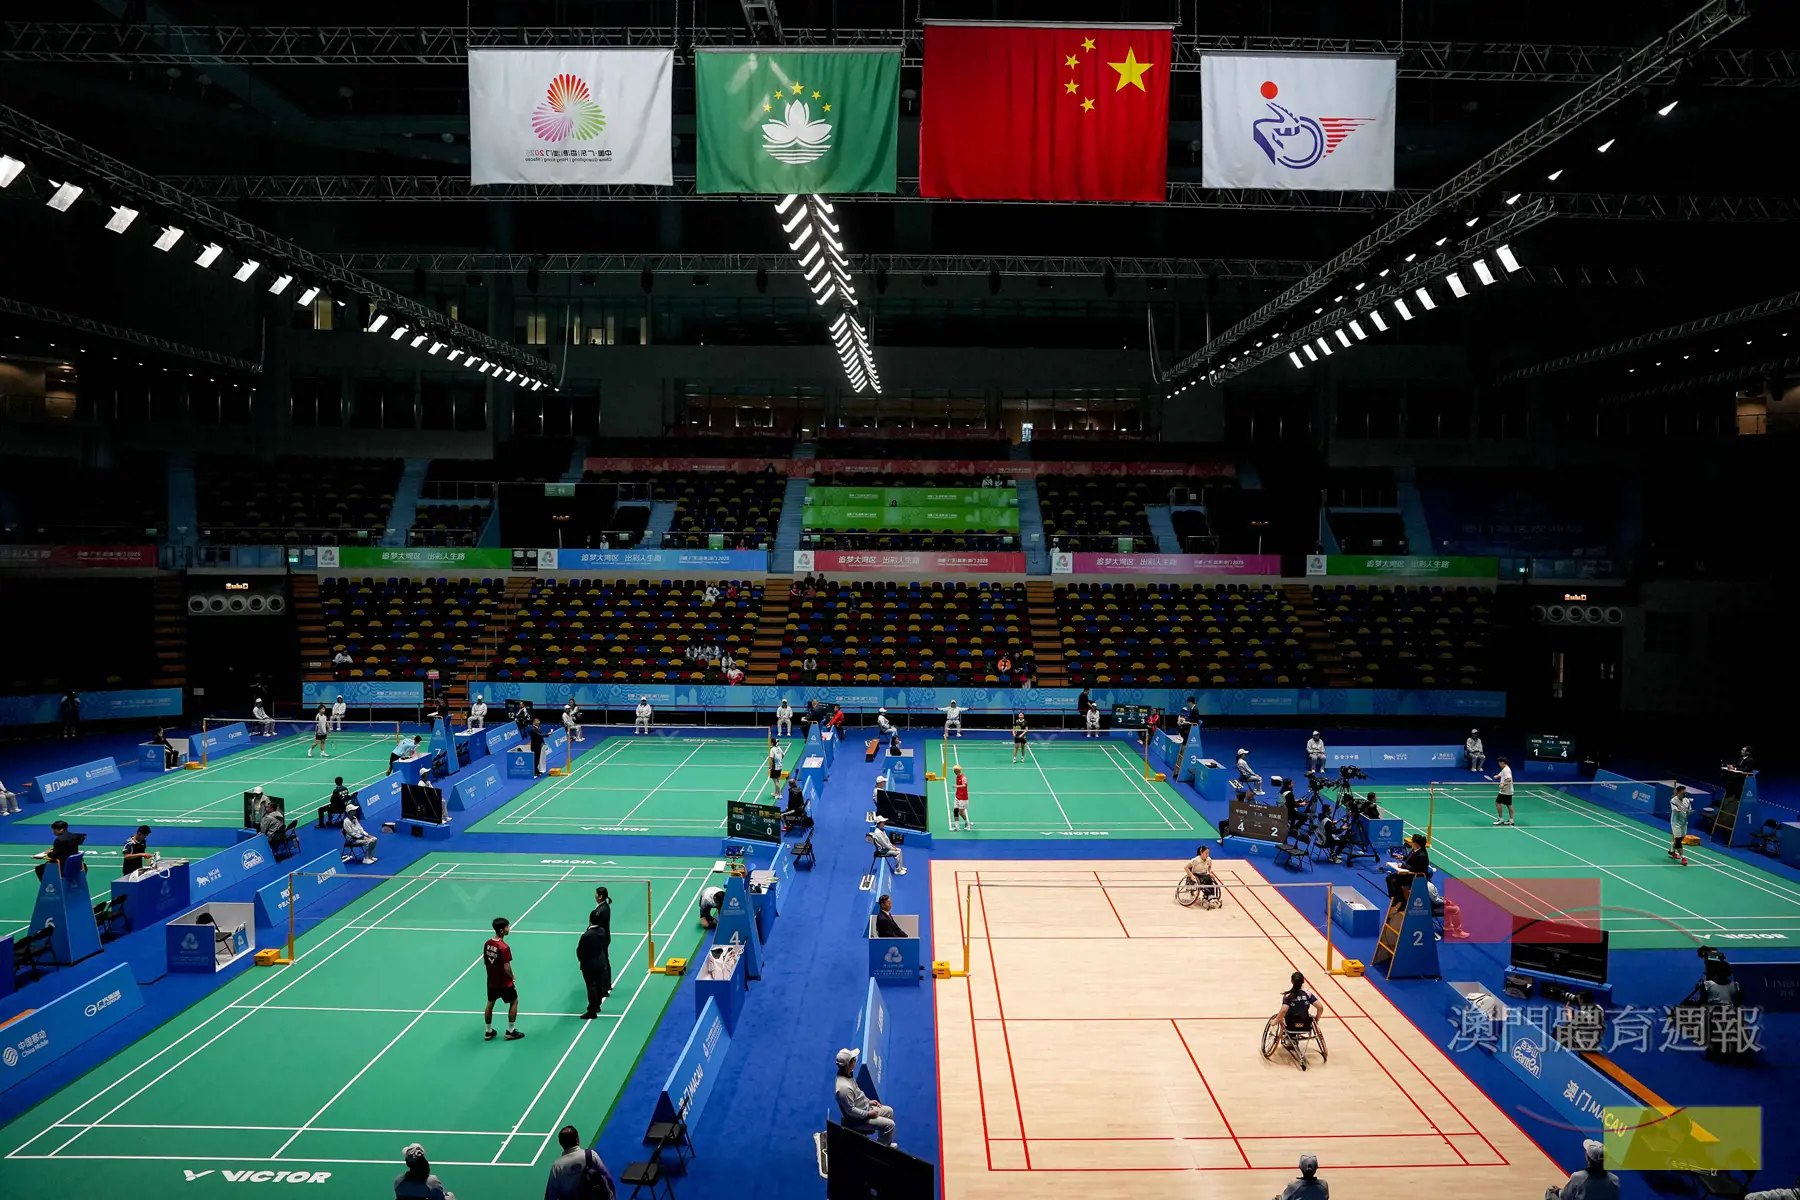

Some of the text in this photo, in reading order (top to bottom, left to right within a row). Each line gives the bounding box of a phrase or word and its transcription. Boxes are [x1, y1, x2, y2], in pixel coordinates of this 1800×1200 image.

[1190, 755, 1197, 764] 3
[1533, 748, 1568, 758] 1 4
[1746, 813, 1751, 824] 1
[735, 822, 772, 836] 0 0
[1237, 821, 1278, 837] 4 2
[729, 930, 741, 945] 4
[1412, 930, 1423, 946] 2
[18, 1030, 47, 1050] 中国移动
[21, 1039, 49, 1058] China Mobile
[1520, 1039, 1539, 1058] 百岁山
[1513, 1046, 1540, 1075] Ganten
[1562, 1079, 1628, 1138] 澳门 MACAU
[221, 1170, 332, 1184] VICTOR
